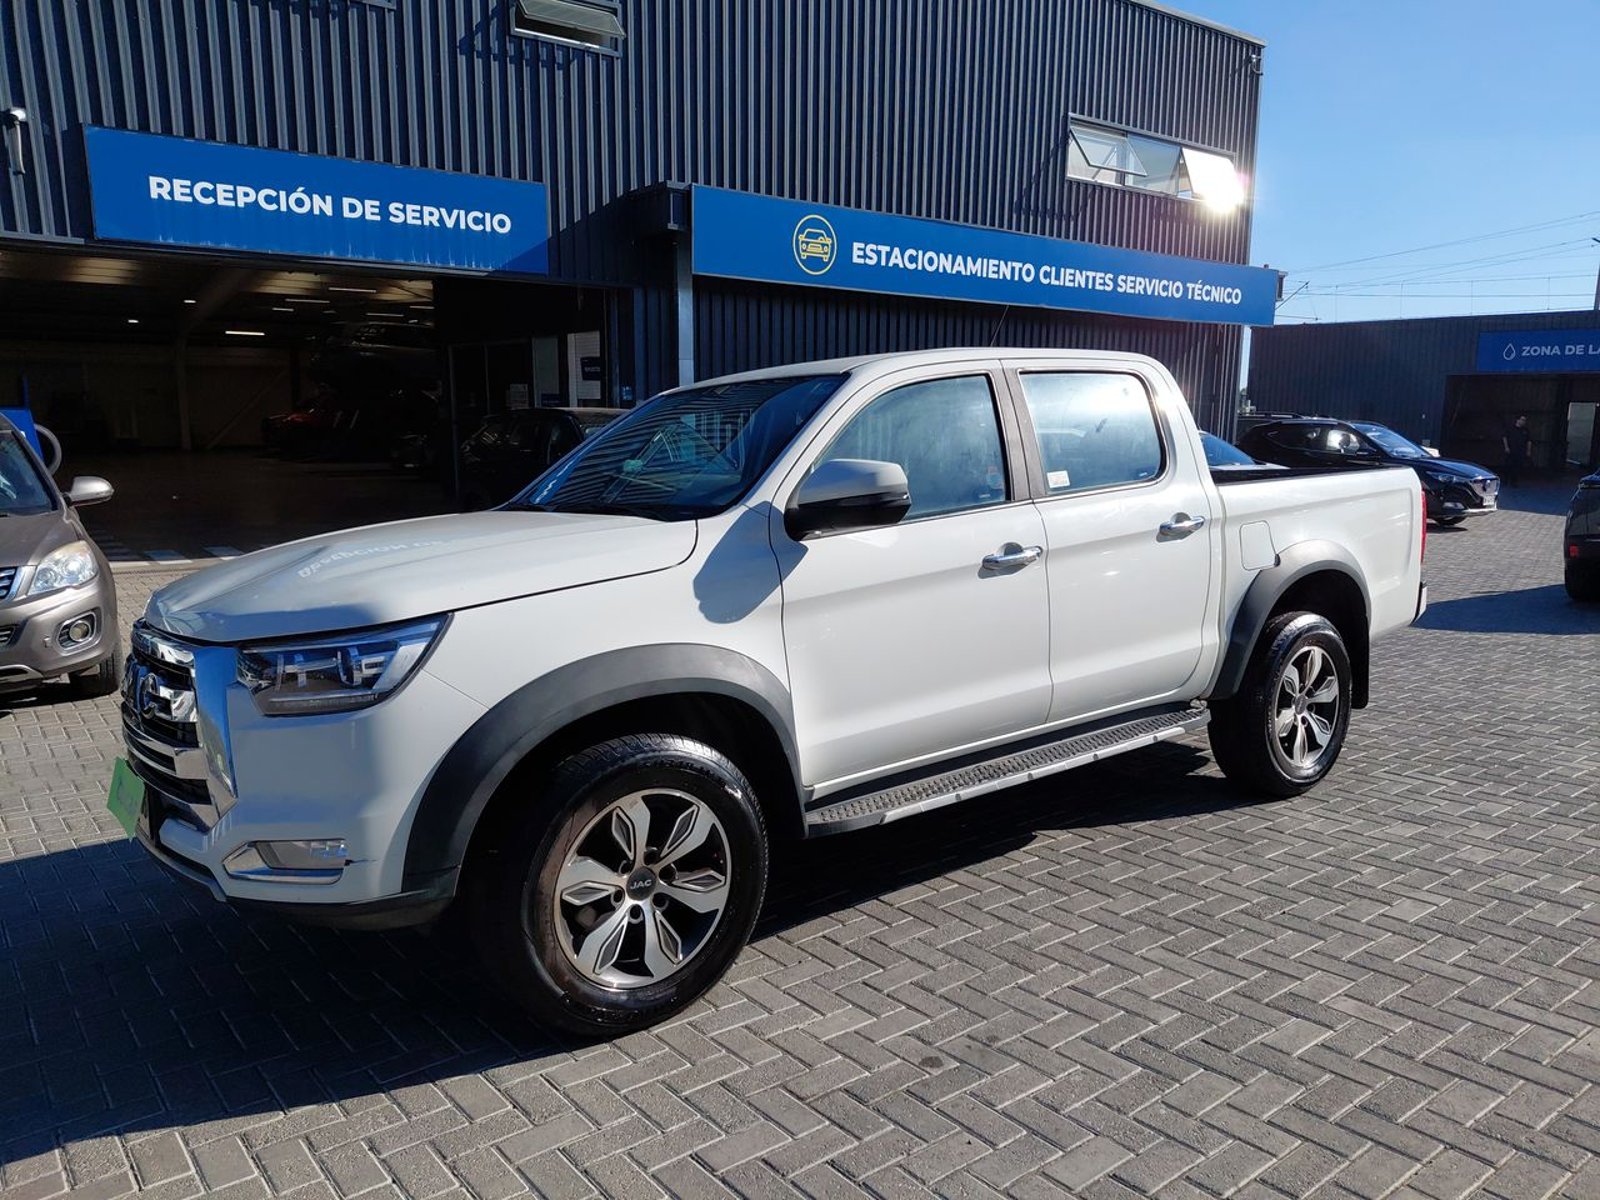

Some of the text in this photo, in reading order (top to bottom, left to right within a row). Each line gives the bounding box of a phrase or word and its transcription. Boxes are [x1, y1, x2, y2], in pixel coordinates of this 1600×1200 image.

[149, 176, 511, 234] RECEPCIÓN DE SERVICIO
[852, 242, 1242, 305] ESTACIONAMIENTO CLIENTES SERVICIO TÉCNICO
[1521, 345, 1561, 356] ZONA
[1564, 345, 1585, 355] DE
[630, 879, 652, 889] JAC
